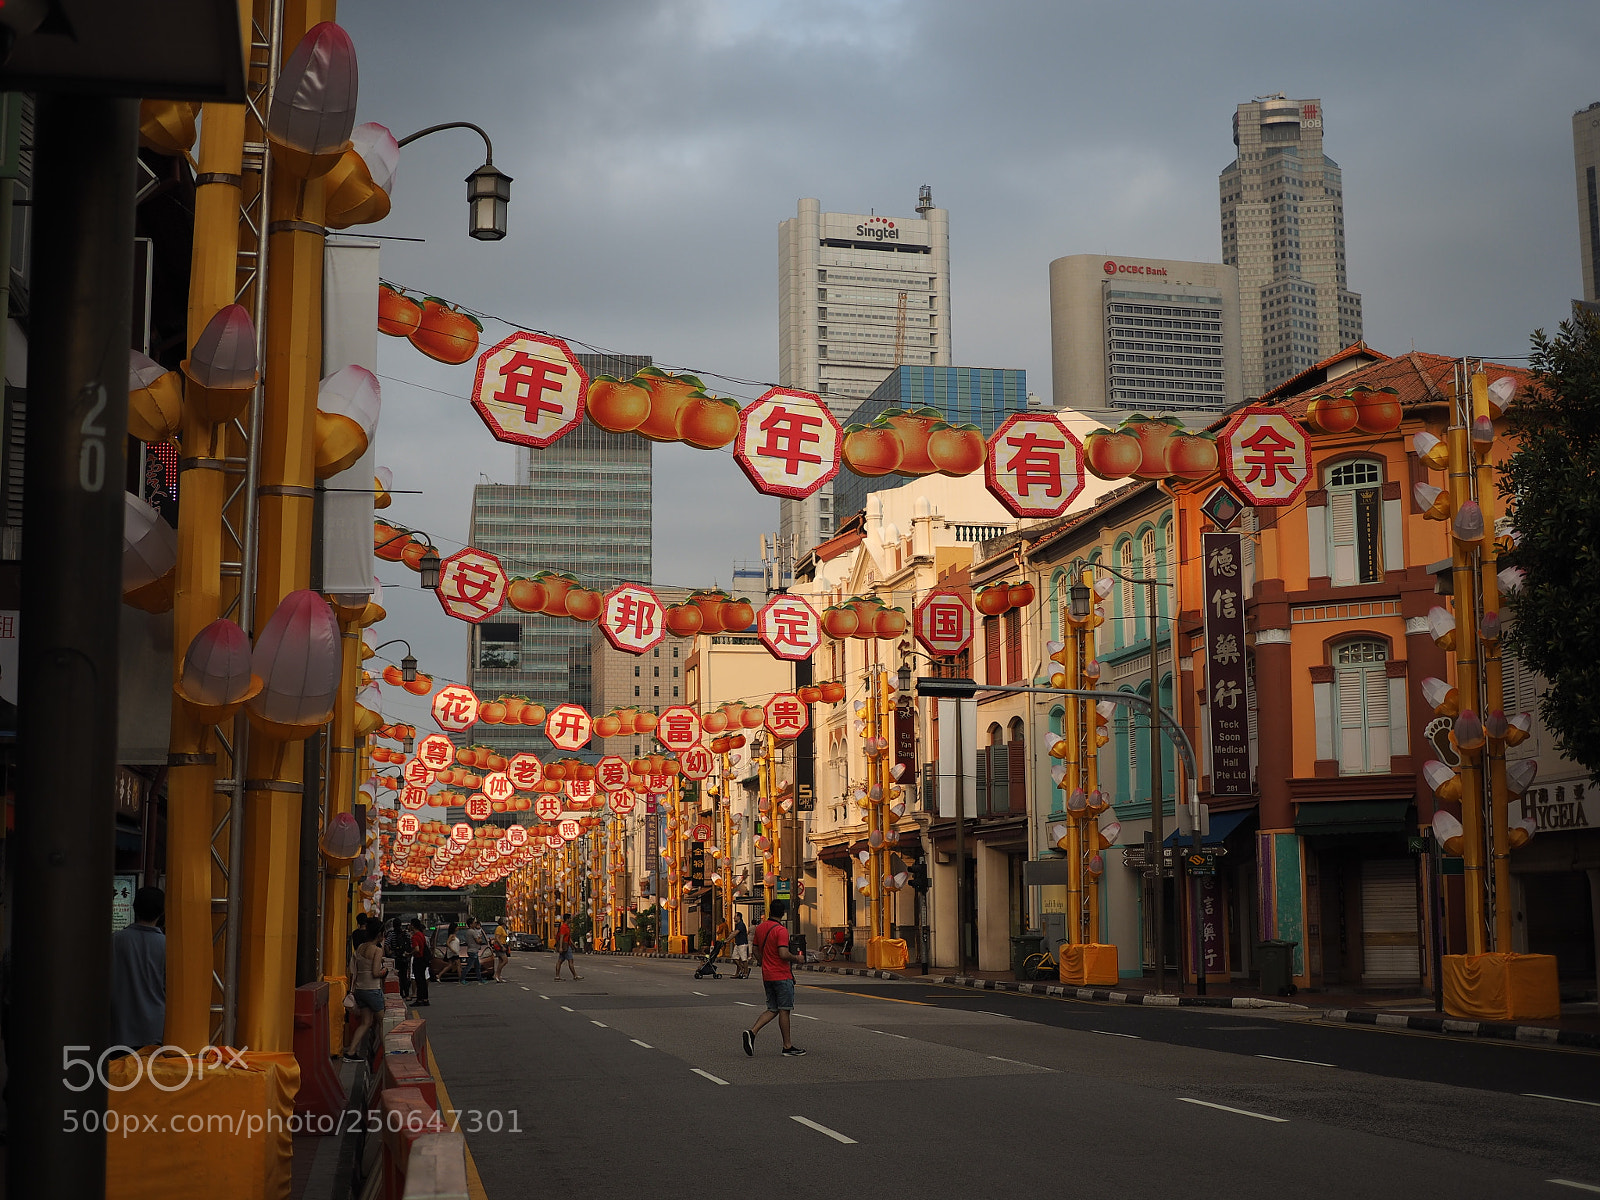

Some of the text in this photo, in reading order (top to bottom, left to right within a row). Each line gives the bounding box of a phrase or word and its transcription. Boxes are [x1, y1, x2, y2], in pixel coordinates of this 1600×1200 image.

[1300, 120, 1322, 128] UOB
[857, 225, 899, 241] Singtel
[1119, 265, 1167, 276] OCBC Bank
[493, 350, 567, 424] 年
[80, 380, 107, 492] 20
[757, 406, 823, 475] 年
[1006, 432, 1065, 498] 有
[1241, 425, 1297, 487] 余
[446, 561, 498, 612] 安
[614, 594, 656, 639] 邦
[930, 603, 964, 642] 国
[773, 607, 811, 648] 定
[440, 692, 472, 723] 花
[772, 701, 801, 730] 贵
[555, 712, 585, 742] 开
[666, 714, 693, 742] 富
[1219, 720, 1239, 729] Teck
[1219, 733, 1240, 741] Soon
[425, 740, 449, 764] 尊
[898, 751, 914, 759] Sang
[1214, 745, 1246, 754] Medical
[514, 760, 537, 784] 老
[686, 751, 708, 774] 幼
[1223, 759, 1239, 767] Hall
[410, 763, 430, 783] 身
[602, 762, 625, 786] 爱
[1216, 771, 1246, 779] Pte Ltd
[404, 787, 423, 804] 和
[489, 776, 509, 796] 体
[570, 779, 591, 797] 健
[470, 798, 488, 815] 睦
[540, 798, 558, 816] 共
[613, 792, 632, 809] 处
[1521, 789, 1588, 829] HYGEIA
[401, 818, 415, 832] 福
[455, 828, 469, 840] 星
[510, 828, 524, 842] 高
[562, 823, 576, 836] 照
